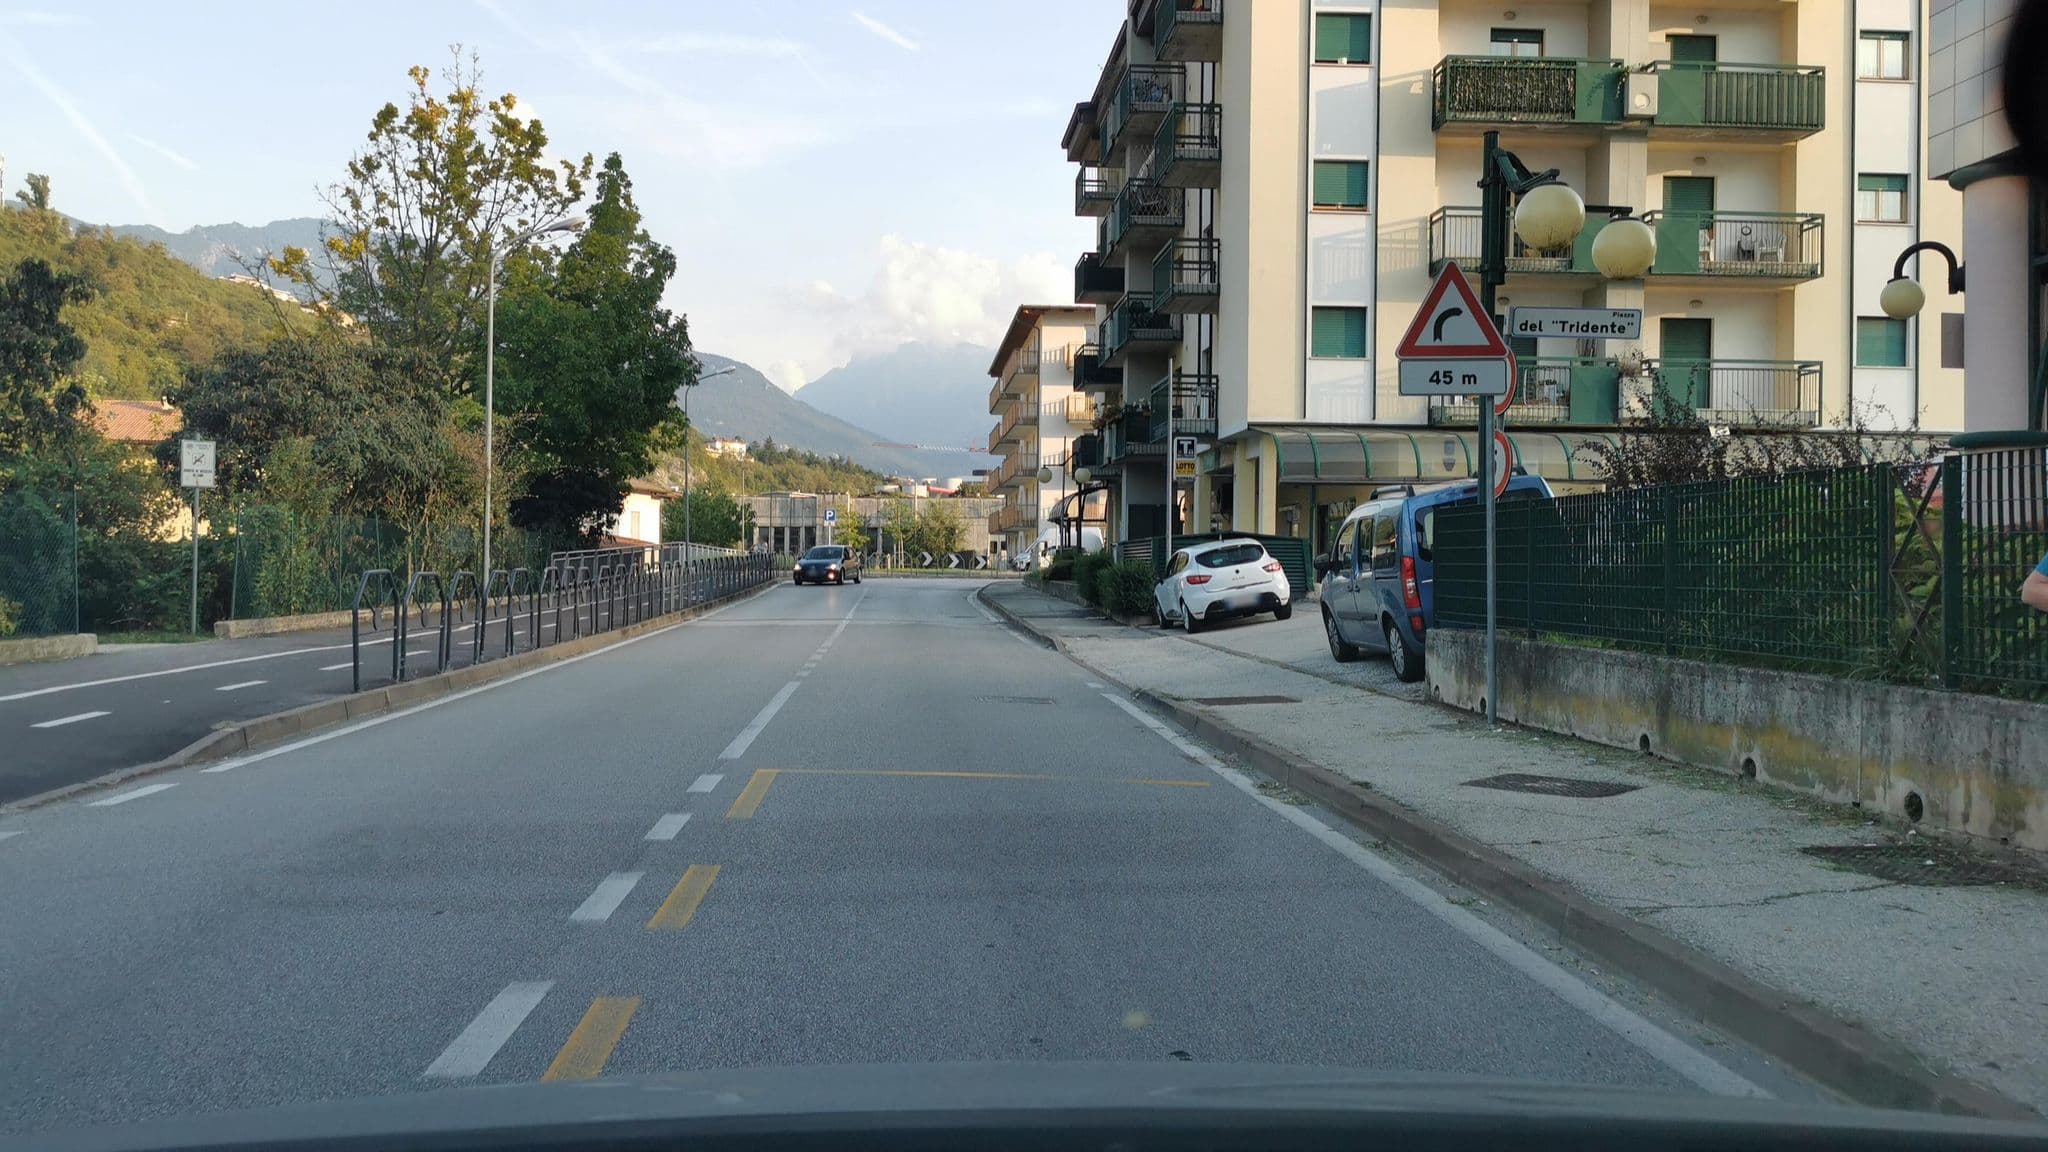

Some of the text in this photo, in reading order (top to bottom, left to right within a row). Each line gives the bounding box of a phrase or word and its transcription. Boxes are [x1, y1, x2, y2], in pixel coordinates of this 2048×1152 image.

[1519, 320, 1634, 334] del "Tridente"
[1428, 370, 1477, 385] 45 m
[1176, 462, 1195, 470] LOTTO
[826, 510, 834, 520] P
